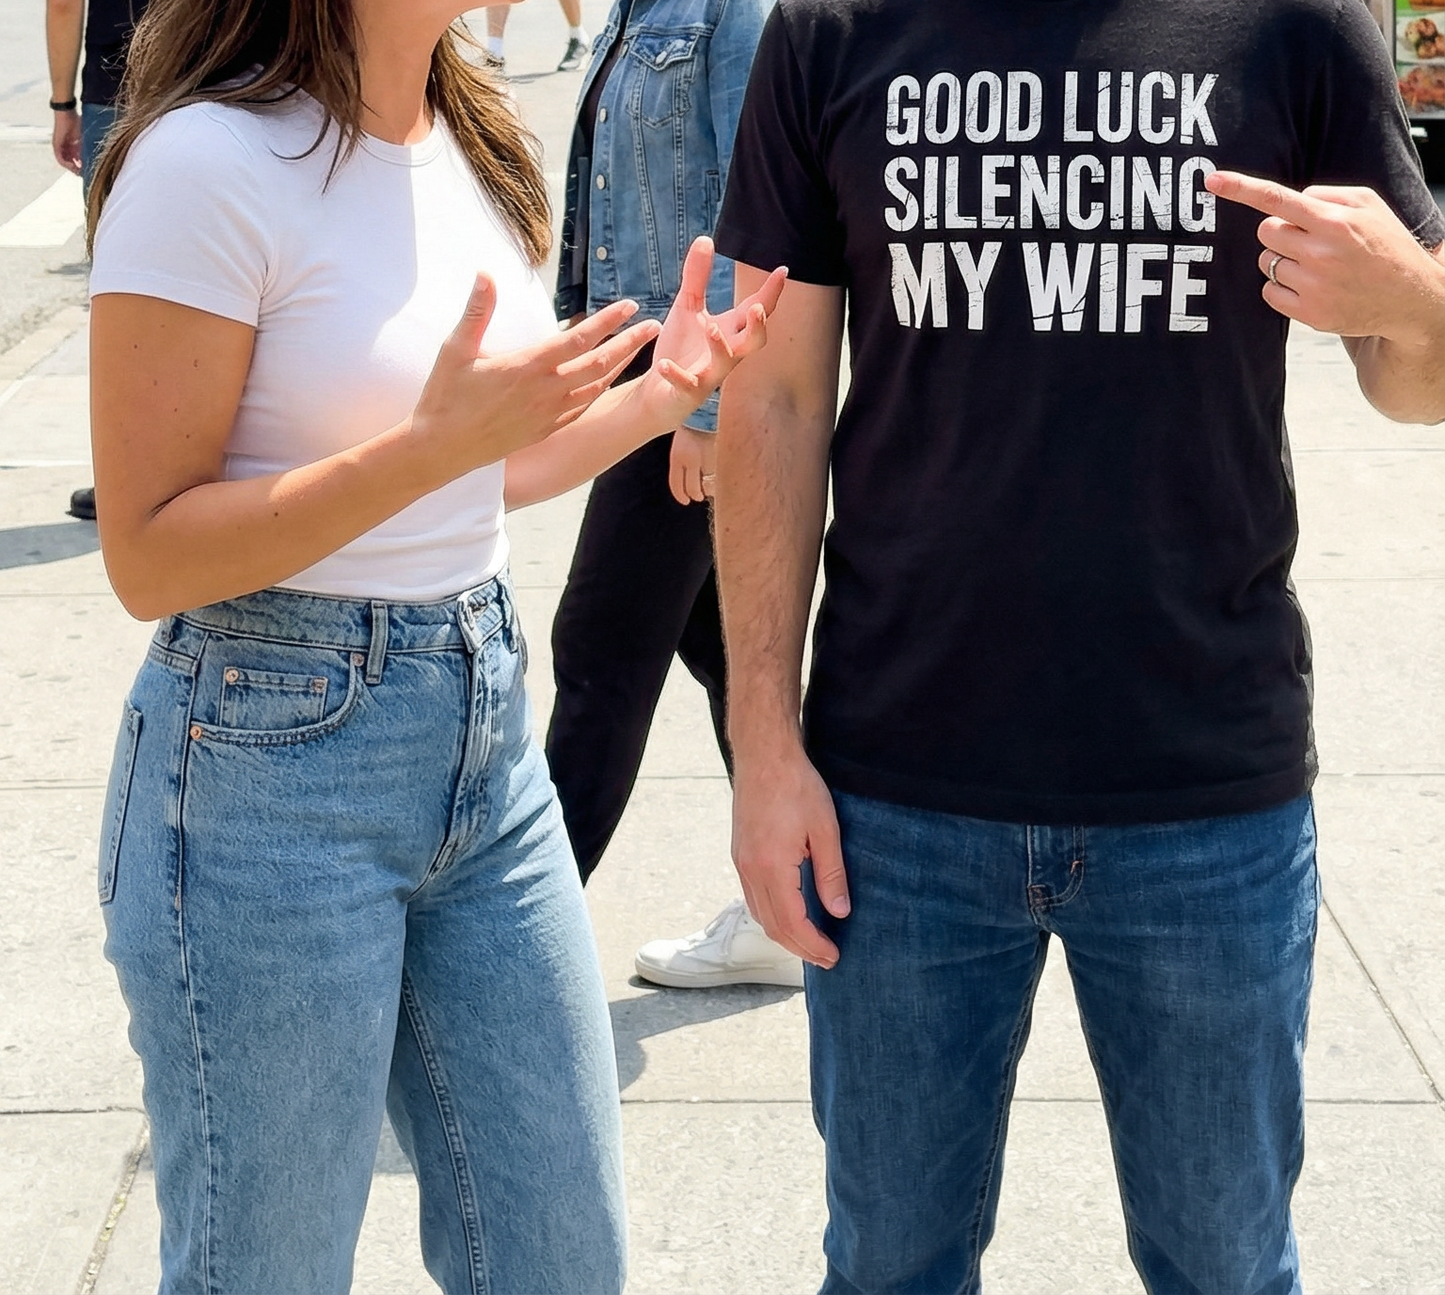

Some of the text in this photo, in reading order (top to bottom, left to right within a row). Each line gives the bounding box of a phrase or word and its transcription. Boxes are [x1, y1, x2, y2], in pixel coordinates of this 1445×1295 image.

[885, 70, 1220, 147] GOOD LUCK
[884, 154, 1218, 233] SILENCING
[887, 241, 1214, 333] MY WIFE
